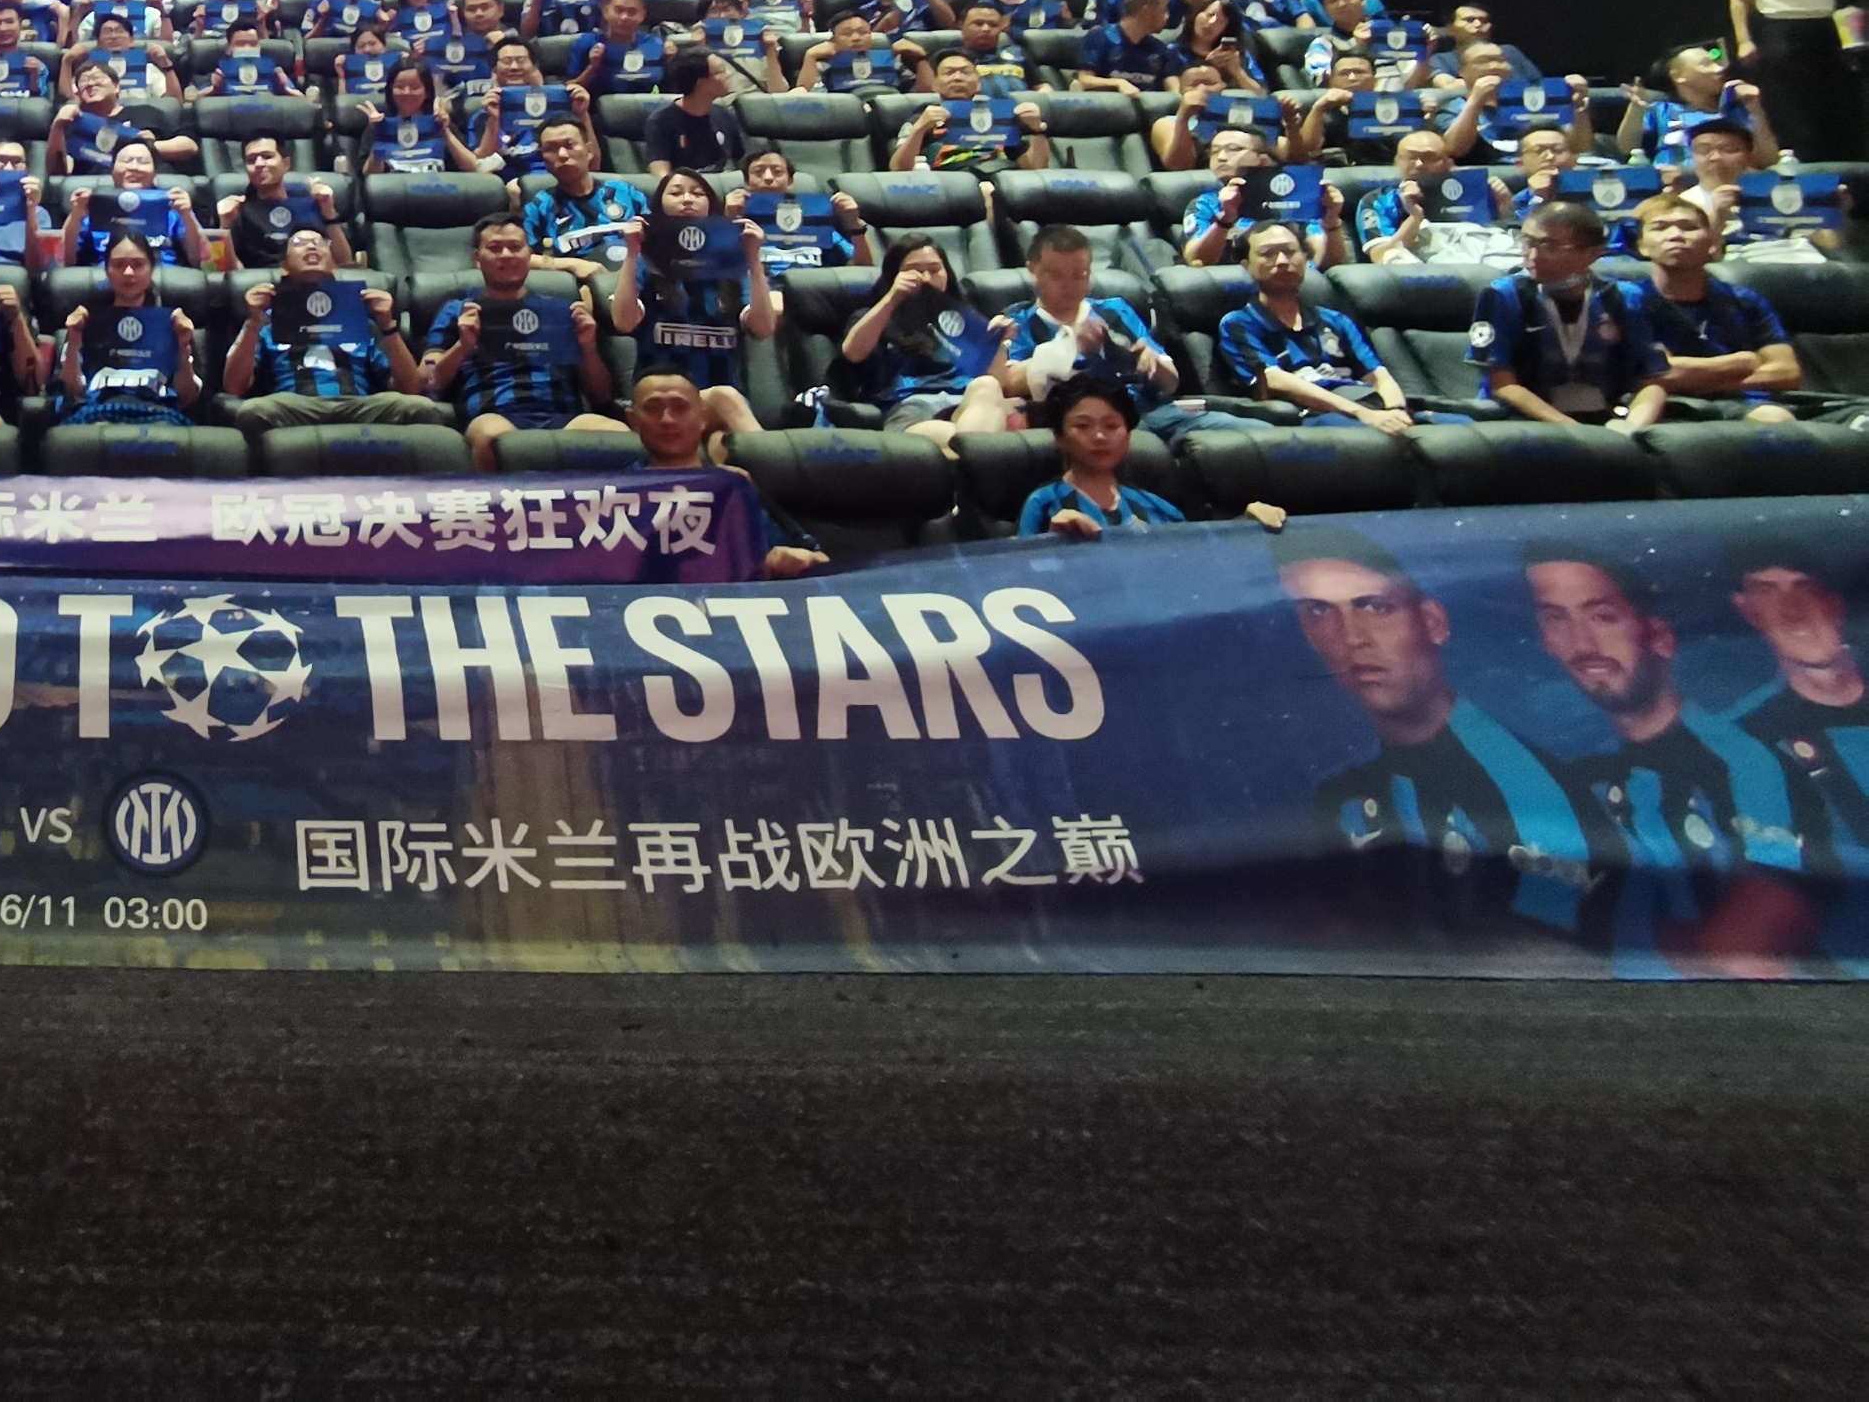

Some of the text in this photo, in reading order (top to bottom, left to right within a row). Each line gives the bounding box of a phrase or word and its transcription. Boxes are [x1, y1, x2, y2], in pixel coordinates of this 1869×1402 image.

[210, 485, 718, 556] 欧冠决赛狂欢夜
[335, 593, 618, 741] THE
[623, 586, 1105, 741] STARS
[20, 807, 73, 843] VS
[296, 812, 1143, 893] 国际米兰再战欧洲之巅
[104, 896, 208, 931] 03:00
